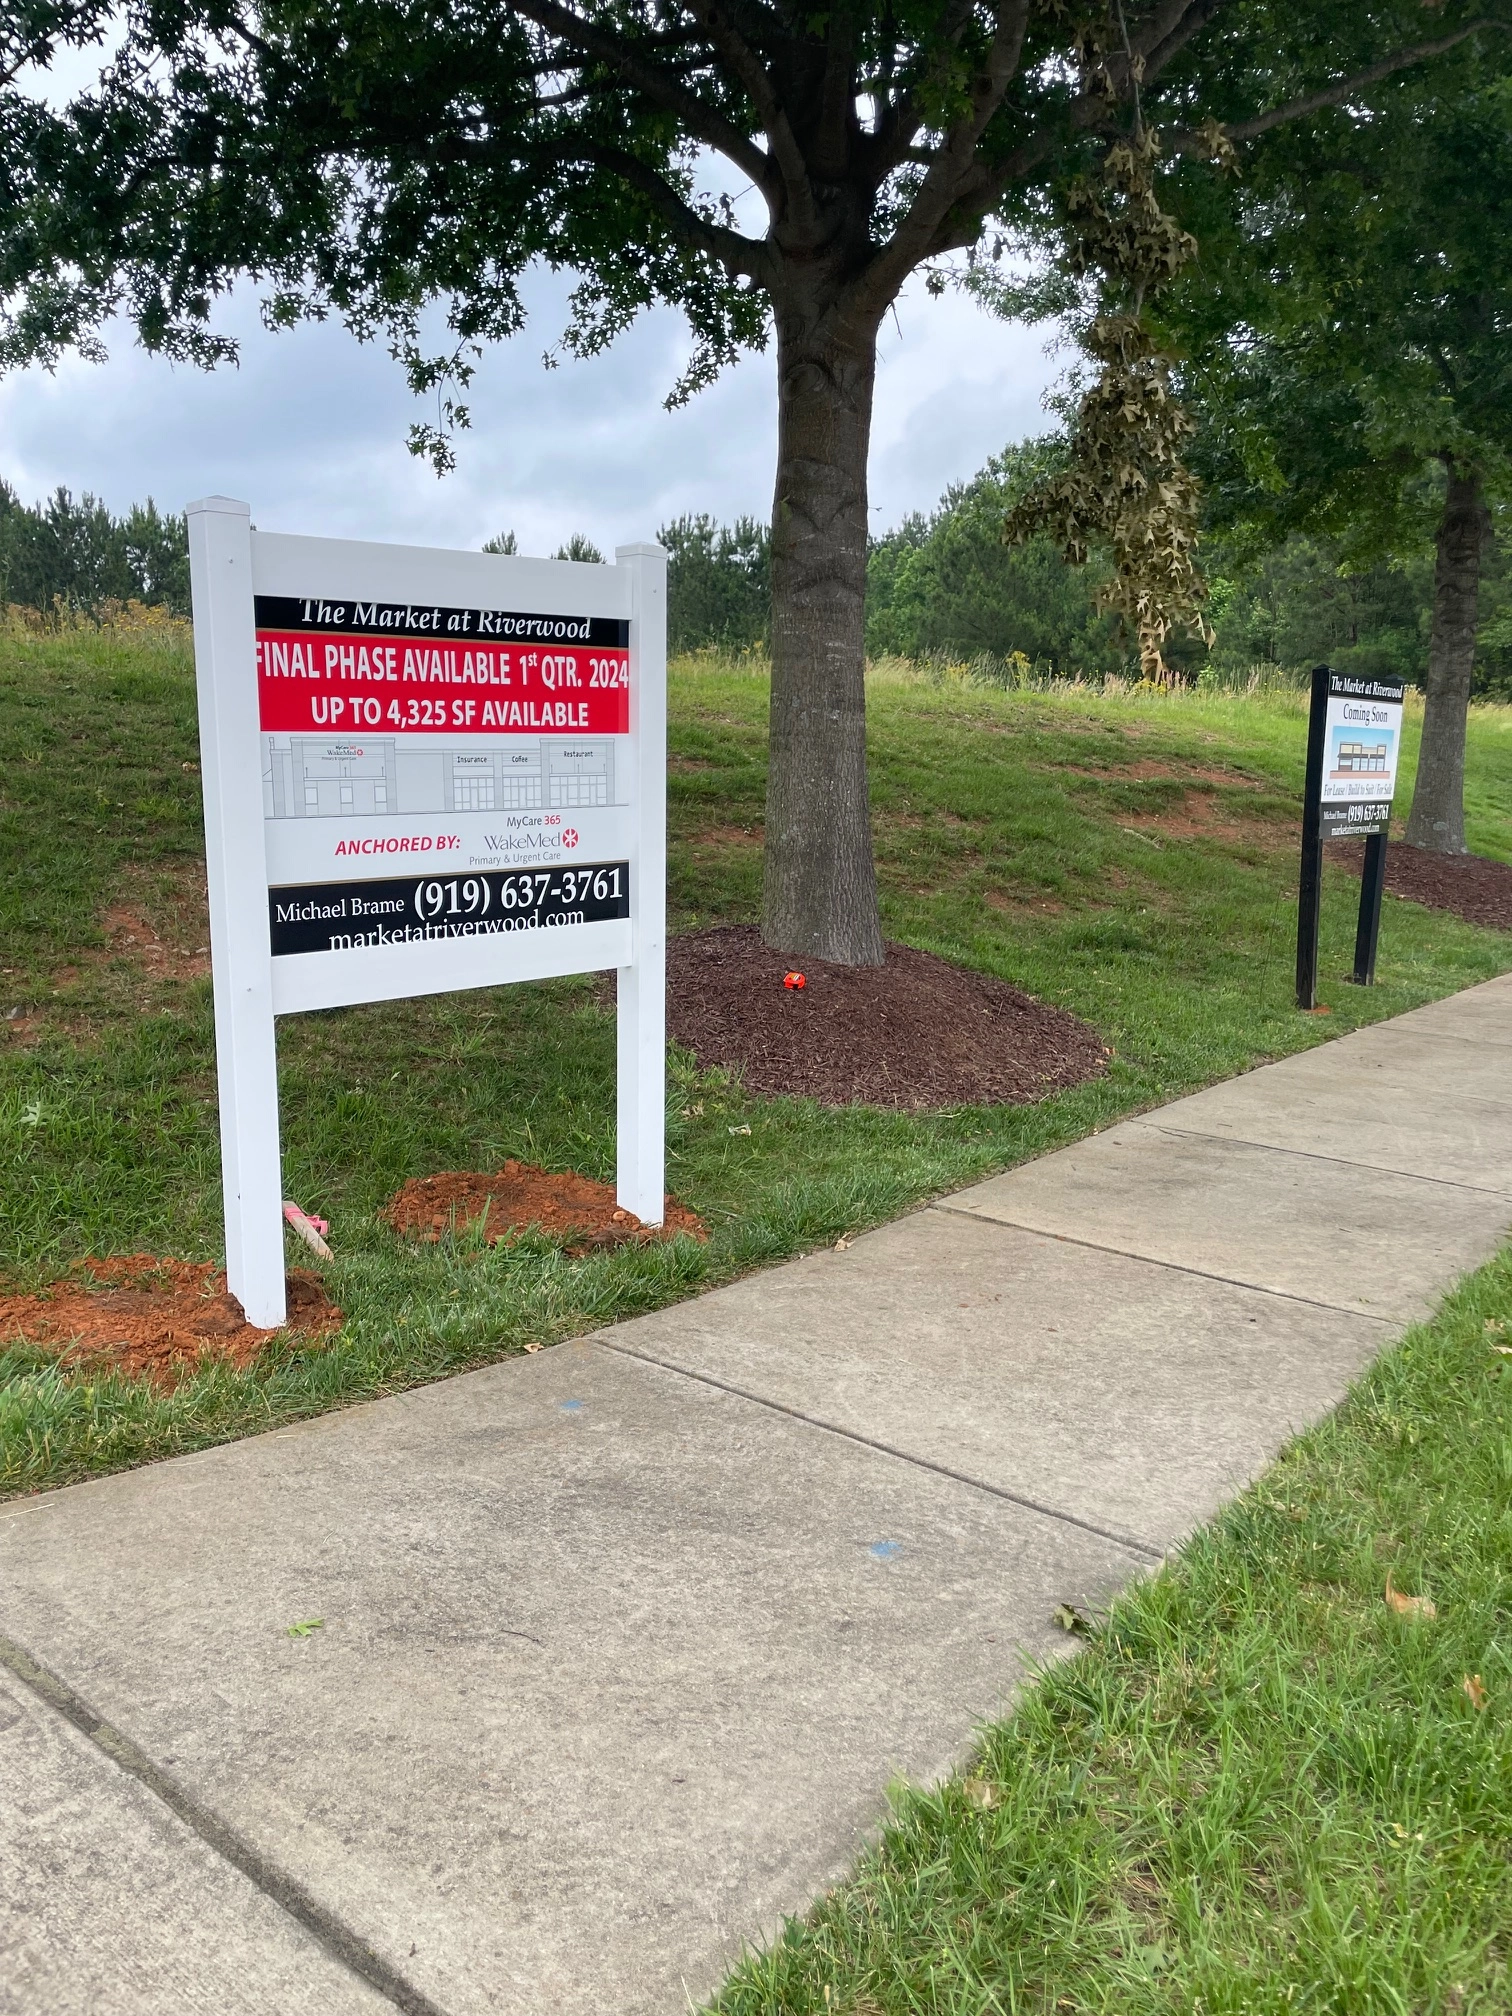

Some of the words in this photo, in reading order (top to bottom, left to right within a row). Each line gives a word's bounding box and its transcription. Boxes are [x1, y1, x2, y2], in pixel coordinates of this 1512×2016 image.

[298, 598, 346, 624] The
[352, 601, 442, 630] Market
[447, 610, 471, 632] at
[476, 609, 591, 639] Riverwood
[325, 644, 398, 681] PHASE
[402, 648, 511, 685] AVAILABLE
[541, 655, 583, 691] QTR.
[589, 658, 629, 688] 2024
[1332, 676, 1343, 691] The
[1343, 678, 1364, 694] Market
[1364, 682, 1373, 695] at
[1373, 682, 1403, 698] Riverwood
[311, 696, 345, 724] UP
[349, 697, 381, 724] TO
[386, 698, 447, 729] 4,325
[452, 700, 476, 726] SF
[481, 700, 589, 727] AVAILABLE
[1343, 703, 1370, 726] Coming
[1372, 706, 1387, 722] Soon
[457, 756, 488, 764] Insurance
[511, 755, 528, 763] Coffee
[563, 750, 594, 758] Restaurant
[1323, 784, 1333, 796] For
[506, 816, 543, 829] MyCare
[544, 814, 561, 826] 365
[1348, 805, 1363, 823] (919)
[1364, 805, 1389, 820] 637-3761
[334, 836, 433, 856] ANCHORED
[436, 835, 461, 851] BY:
[483, 832, 561, 851] WakeMed
[469, 856, 502, 867] Primary
[503, 854, 511, 864] &
[513, 853, 541, 865] Urgent
[543, 851, 561, 861] Care
[275, 898, 347, 923] Michael
[350, 897, 405, 916] Brame
[414, 876, 491, 921] (919)
[500, 867, 623, 910] 637-3761
[328, 908, 585, 951] marketatriverwood.com
